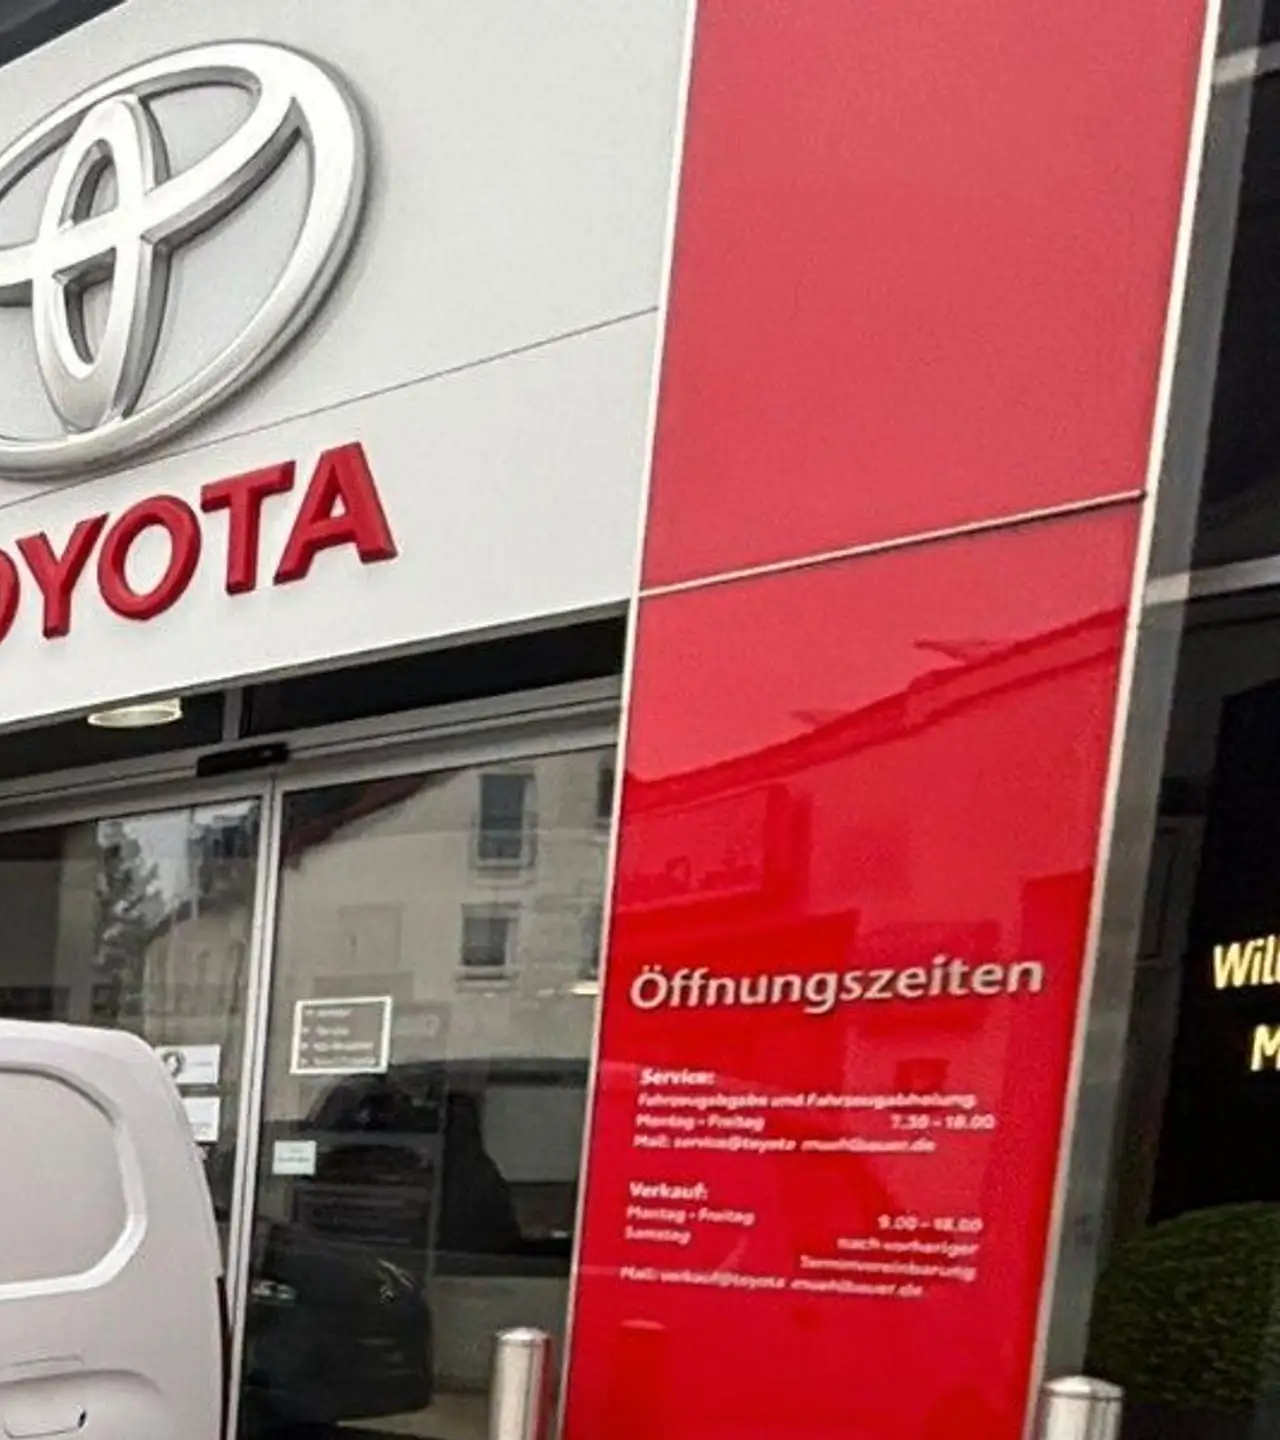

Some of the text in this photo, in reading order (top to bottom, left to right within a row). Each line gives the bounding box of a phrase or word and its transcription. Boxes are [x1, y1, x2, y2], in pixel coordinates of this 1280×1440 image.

[630, 953, 1046, 1014] Öffnungszeiten
[640, 1067, 716, 1086] Service:
[707, 1113, 765, 1132] Freitag
[629, 1181, 709, 1200] Verkauf:
[697, 1206, 755, 1226] Freitag
